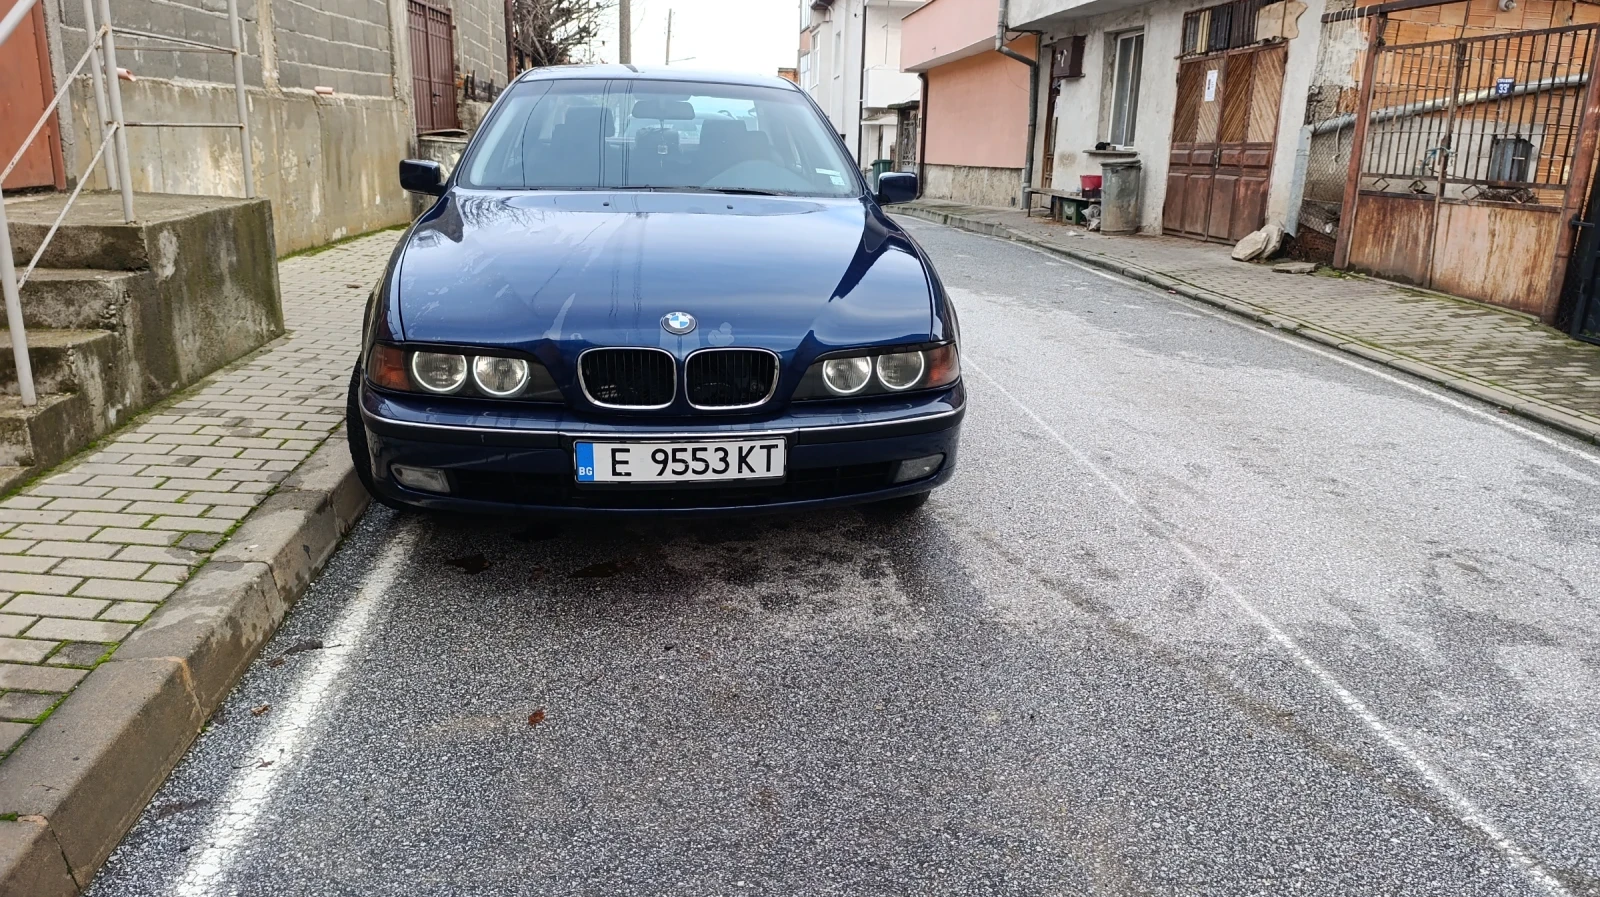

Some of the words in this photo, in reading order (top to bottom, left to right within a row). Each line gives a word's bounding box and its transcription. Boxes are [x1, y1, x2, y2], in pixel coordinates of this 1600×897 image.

[611, 448, 631, 476] E
[651, 446, 730, 476] 9553
[738, 444, 778, 473] KT
[578, 466, 593, 476] BG
